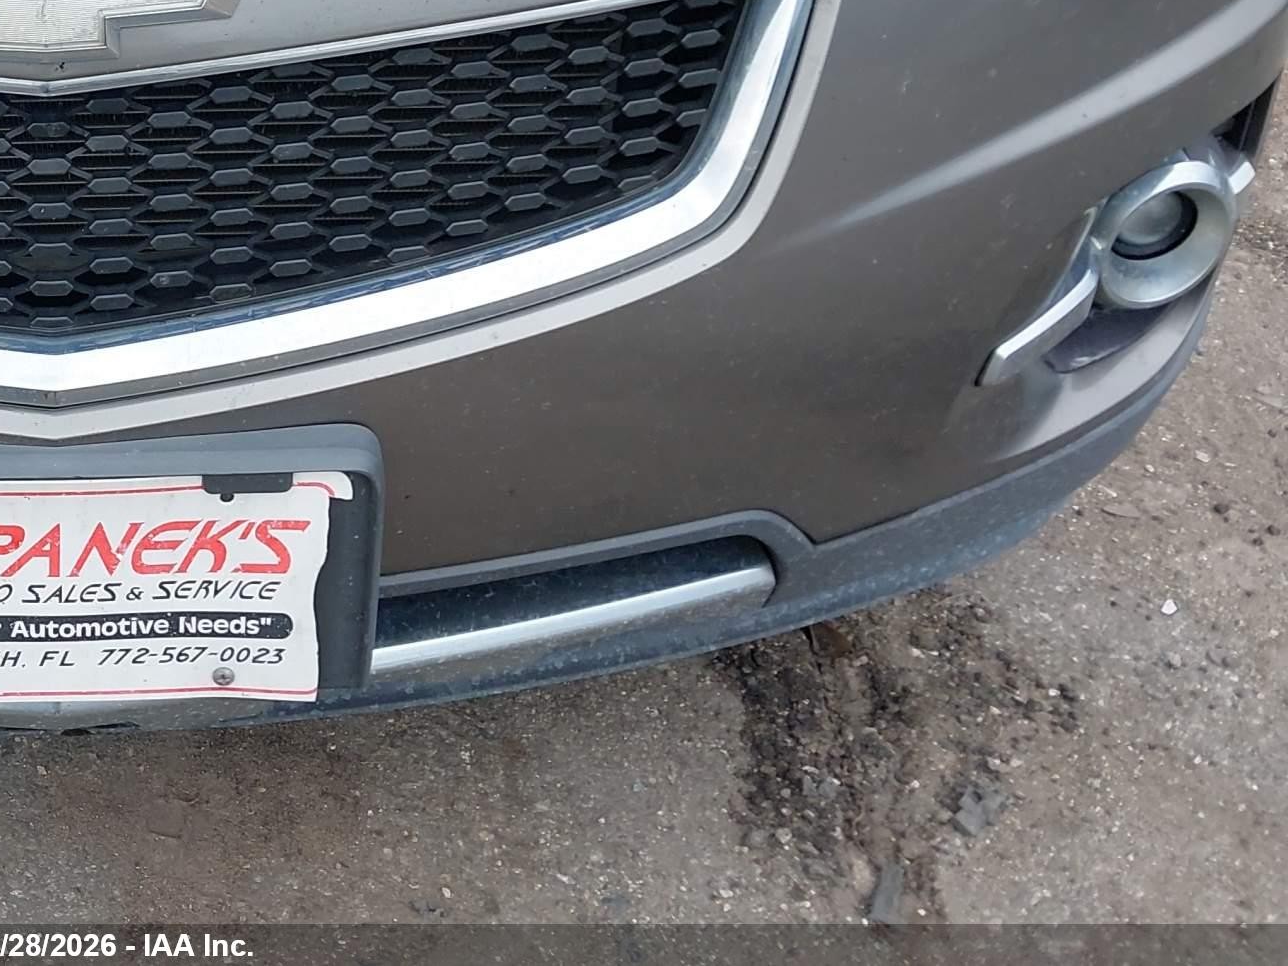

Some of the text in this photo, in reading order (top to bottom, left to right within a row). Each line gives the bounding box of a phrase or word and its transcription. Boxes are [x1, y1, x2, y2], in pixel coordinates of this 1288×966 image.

[21, 582, 122, 604] SALES
[126, 586, 144, 601] &
[152, 580, 281, 600] SERVICE
[11, 616, 170, 639] Automotive
[178, 615, 272, 635] Needs"
[39, 650, 75, 667] FL
[98, 646, 286, 666] 772-567-0023
